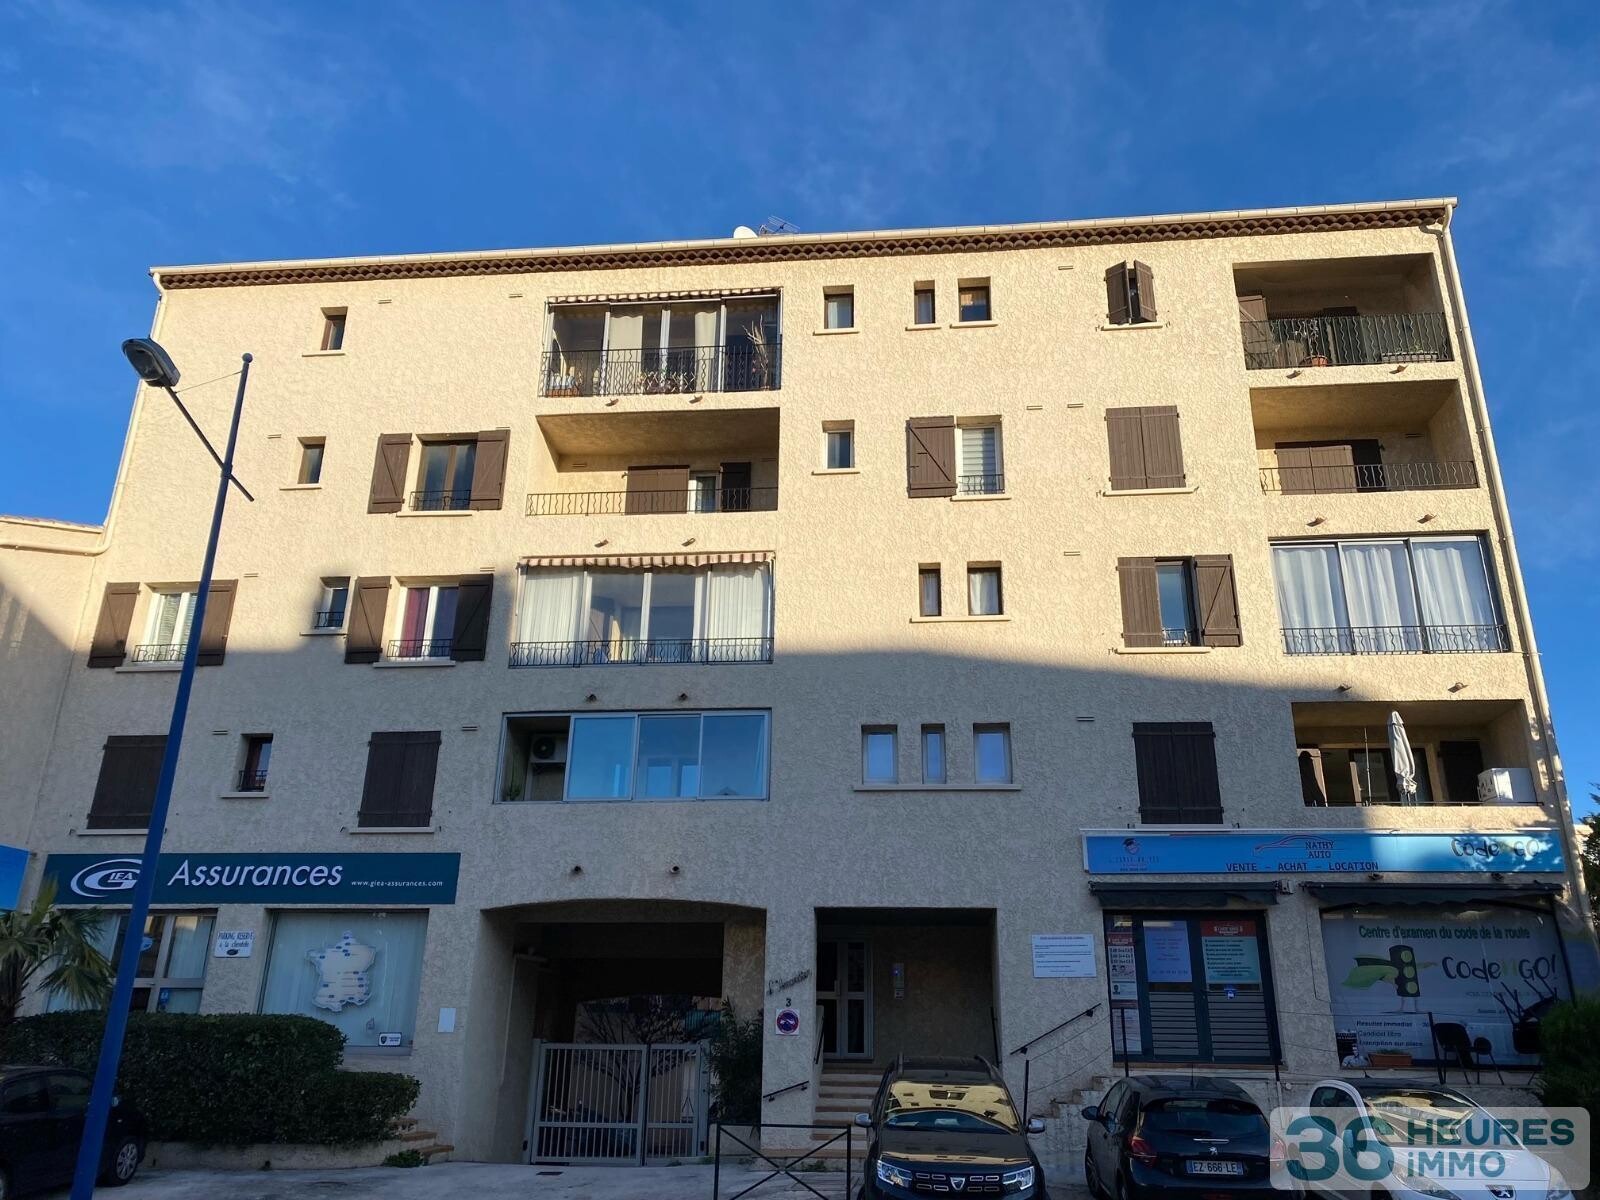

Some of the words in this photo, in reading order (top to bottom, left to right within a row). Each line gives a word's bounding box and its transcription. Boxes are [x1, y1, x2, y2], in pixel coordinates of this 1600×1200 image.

[1308, 850, 1331, 859] AUTO
[1225, 862, 1257, 872] VENTE
[1278, 862, 1307, 872] ACHAT
[1329, 861, 1379, 871] LOCATION
[167, 859, 343, 886] Assurances
[1359, 925, 1390, 939] Centre
[1392, 925, 1437, 939] d'examen
[1441, 925, 1453, 939] du
[1454, 926, 1479, 939] code
[1480, 926, 1491, 939] de
[1492, 926, 1503, 939] la
[1504, 928, 1530, 939] route
[785, 998, 792, 1007] 3
